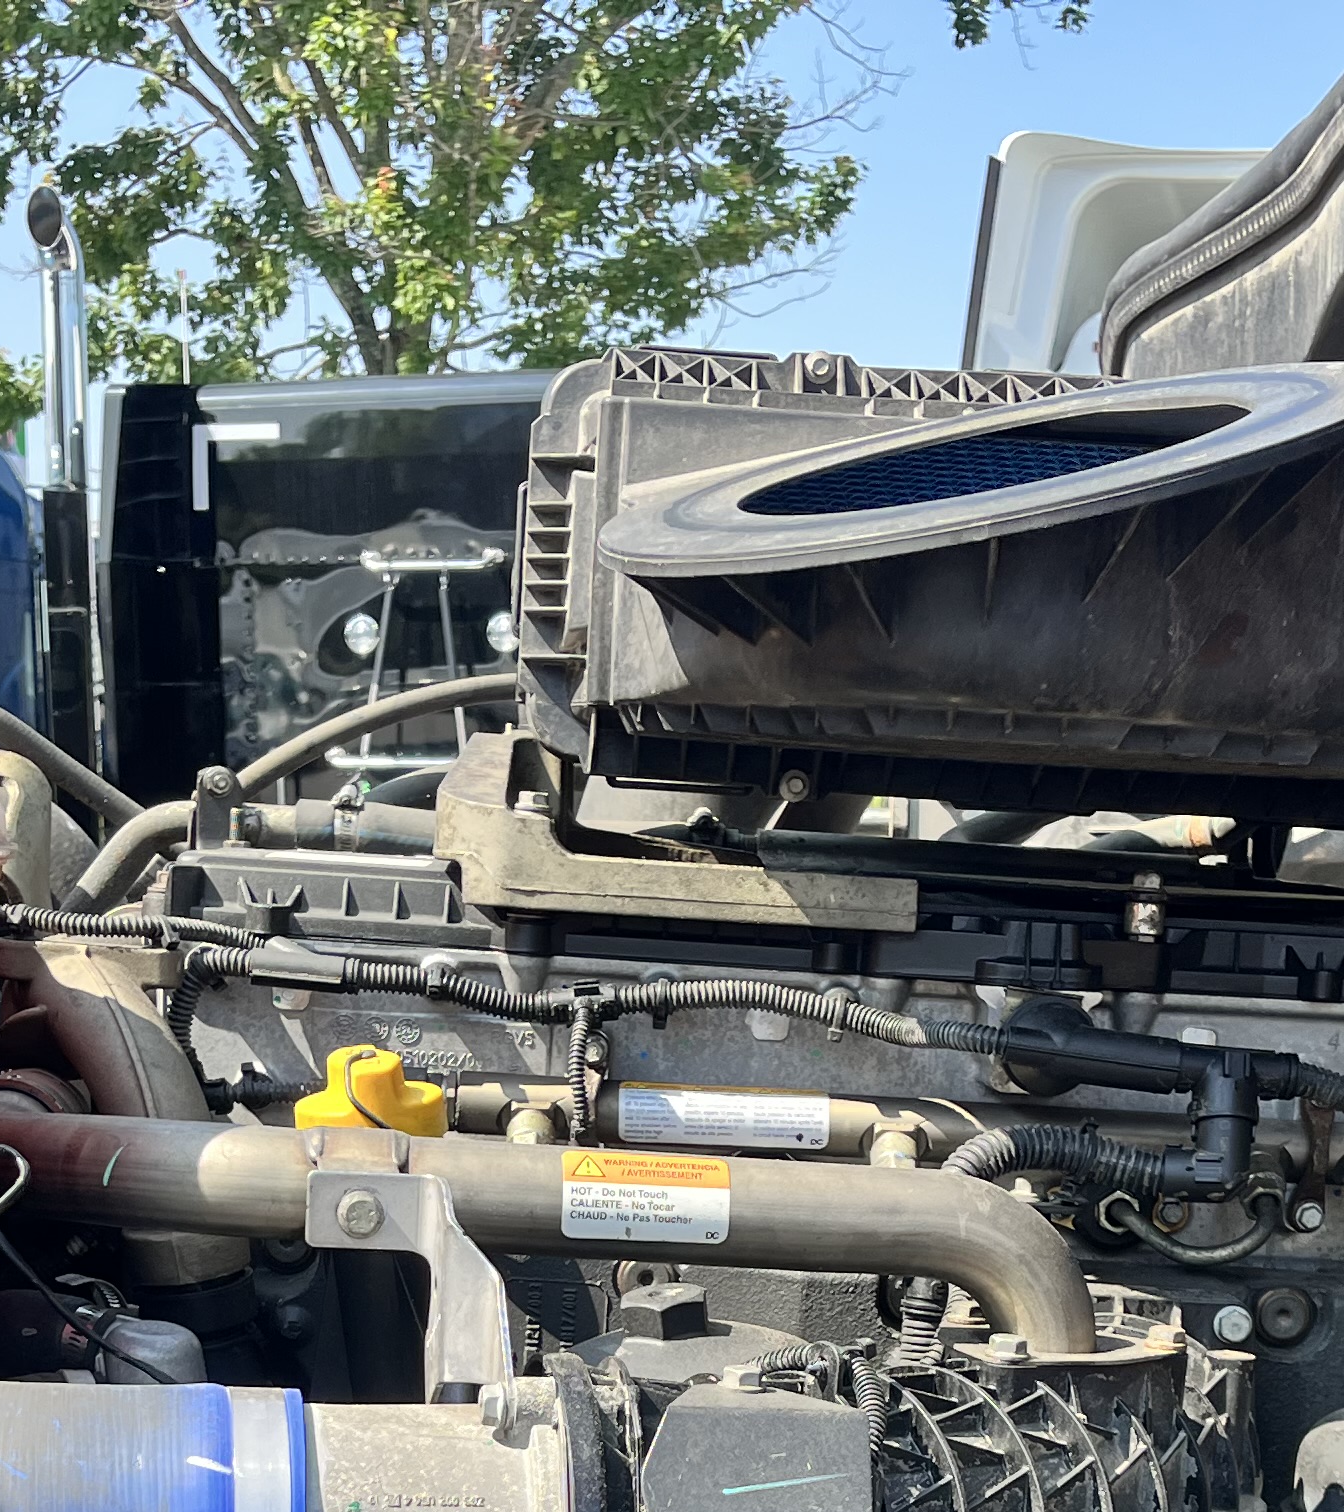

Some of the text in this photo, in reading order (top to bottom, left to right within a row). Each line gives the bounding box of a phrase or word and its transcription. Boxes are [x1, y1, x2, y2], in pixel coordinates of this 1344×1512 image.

[604, 1159, 648, 1168] WARNING
[655, 1162, 720, 1171] ADVERTENCIA
[628, 1170, 703, 1180] AVERTISSEMENT
[571, 1186, 593, 1195] HOT
[602, 1188, 615, 1197] Do
[619, 1189, 636, 1197] Not
[638, 1190, 668, 1199] Touch
[571, 1199, 622, 1209] CALIENTE
[632, 1202, 645, 1210] No
[647, 1202, 675, 1211] Tocar
[570, 1211, 606, 1220] CHAUD
[617, 1213, 629, 1221] Ne
[633, 1214, 650, 1222] Pas
[654, 1215, 692, 1224] Toucher
